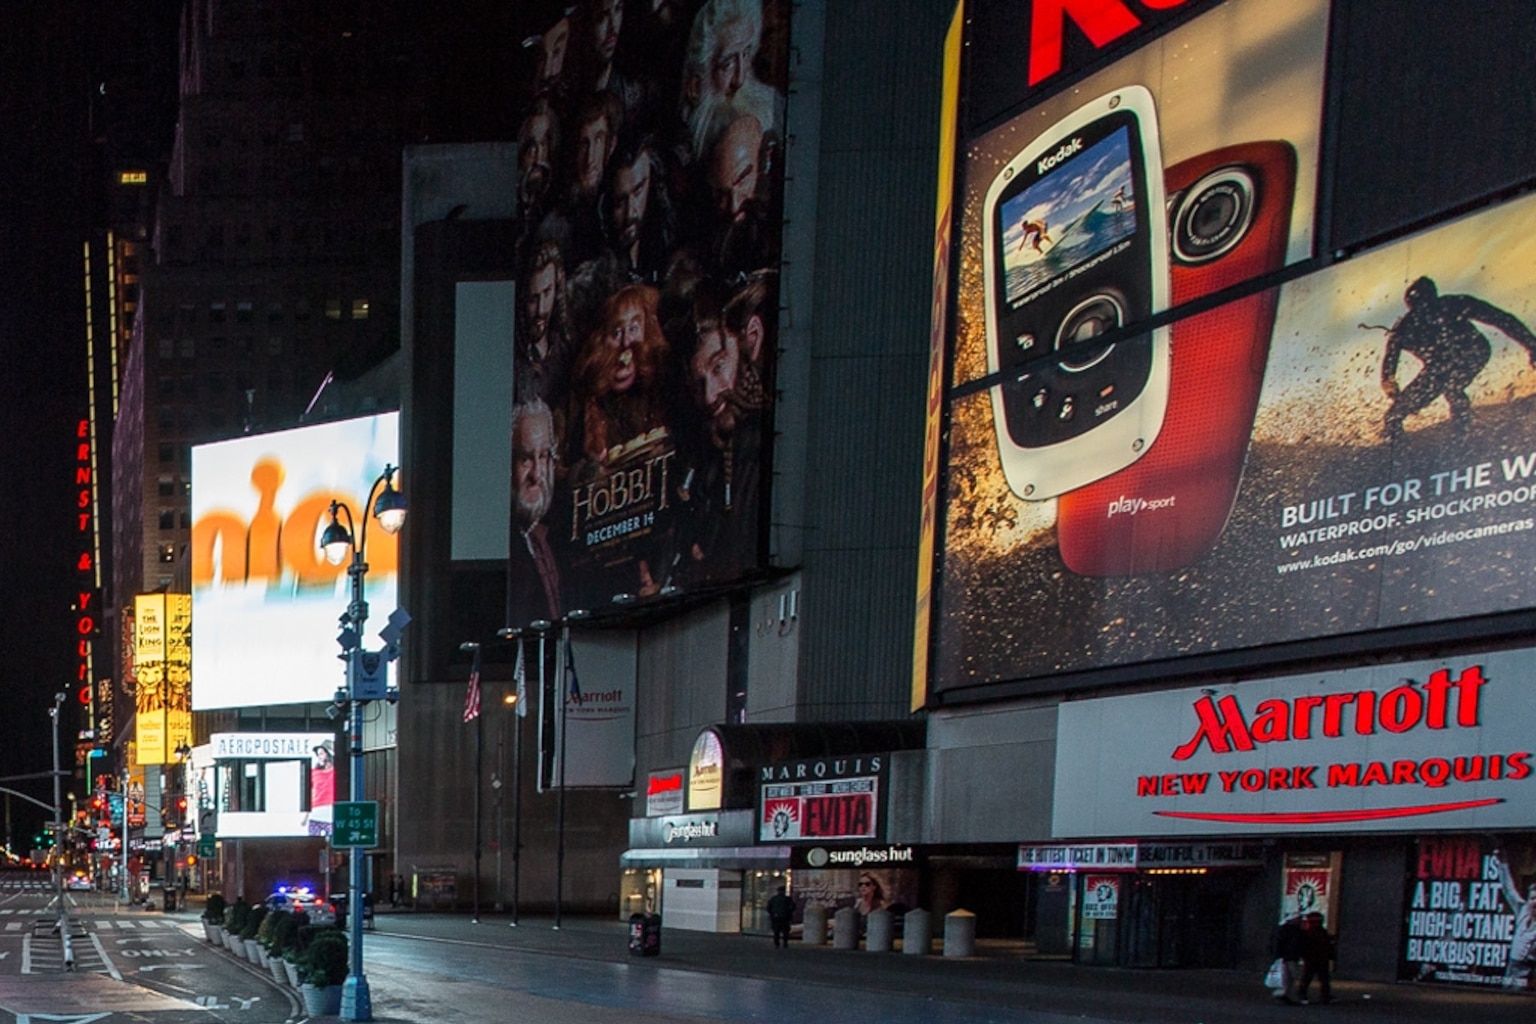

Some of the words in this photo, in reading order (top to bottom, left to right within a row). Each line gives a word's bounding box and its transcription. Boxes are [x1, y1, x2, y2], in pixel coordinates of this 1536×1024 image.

[1038, 137, 1083, 174] Kodak
[77, 420, 91, 532] ERNST
[1281, 491, 1357, 528] BUILT
[1365, 478, 1422, 511] FOR
[1430, 461, 1493, 497] THE
[1501, 453, 1536, 481] W
[586, 515, 641, 547] DECEMBER
[643, 511, 655, 527] 14
[1280, 512, 1401, 550] WATERPROOF.
[1276, 517, 1534, 574] www.kodak.com/go/videocameras
[77, 553, 92, 571] &
[140, 625, 160, 635] LION
[142, 615, 157, 623] THE
[138, 638, 162, 648] KING
[1171, 664, 1487, 761] Marriott
[762, 757, 881, 781] MARQUIS
[1137, 771, 1210, 798] NEW
[1220, 764, 1319, 794] YORK
[1326, 751, 1533, 788] MARQUIS
[335, 819, 346, 829] W
[348, 819, 361, 829] 45
[363, 819, 375, 829] St
[348, 807, 361, 816] To
[805, 794, 870, 836] EVITA
[829, 847, 888, 867] sunglass
[889, 846, 914, 862] hut
[1068, 847, 1094, 862] TICKET
[1096, 847, 1105, 862] IN
[1417, 836, 1482, 880] EVITA
[1483, 855, 1500, 881] IS
[1412, 881, 1425, 908] A
[1430, 881, 1464, 911] BIG,
[1468, 882, 1504, 913] FAT,
[1409, 910, 1515, 941] HIGH-OCTANE
[120, 947, 196, 959] ONLY
[1407, 937, 1508, 967] BLOCKBUSTER!
